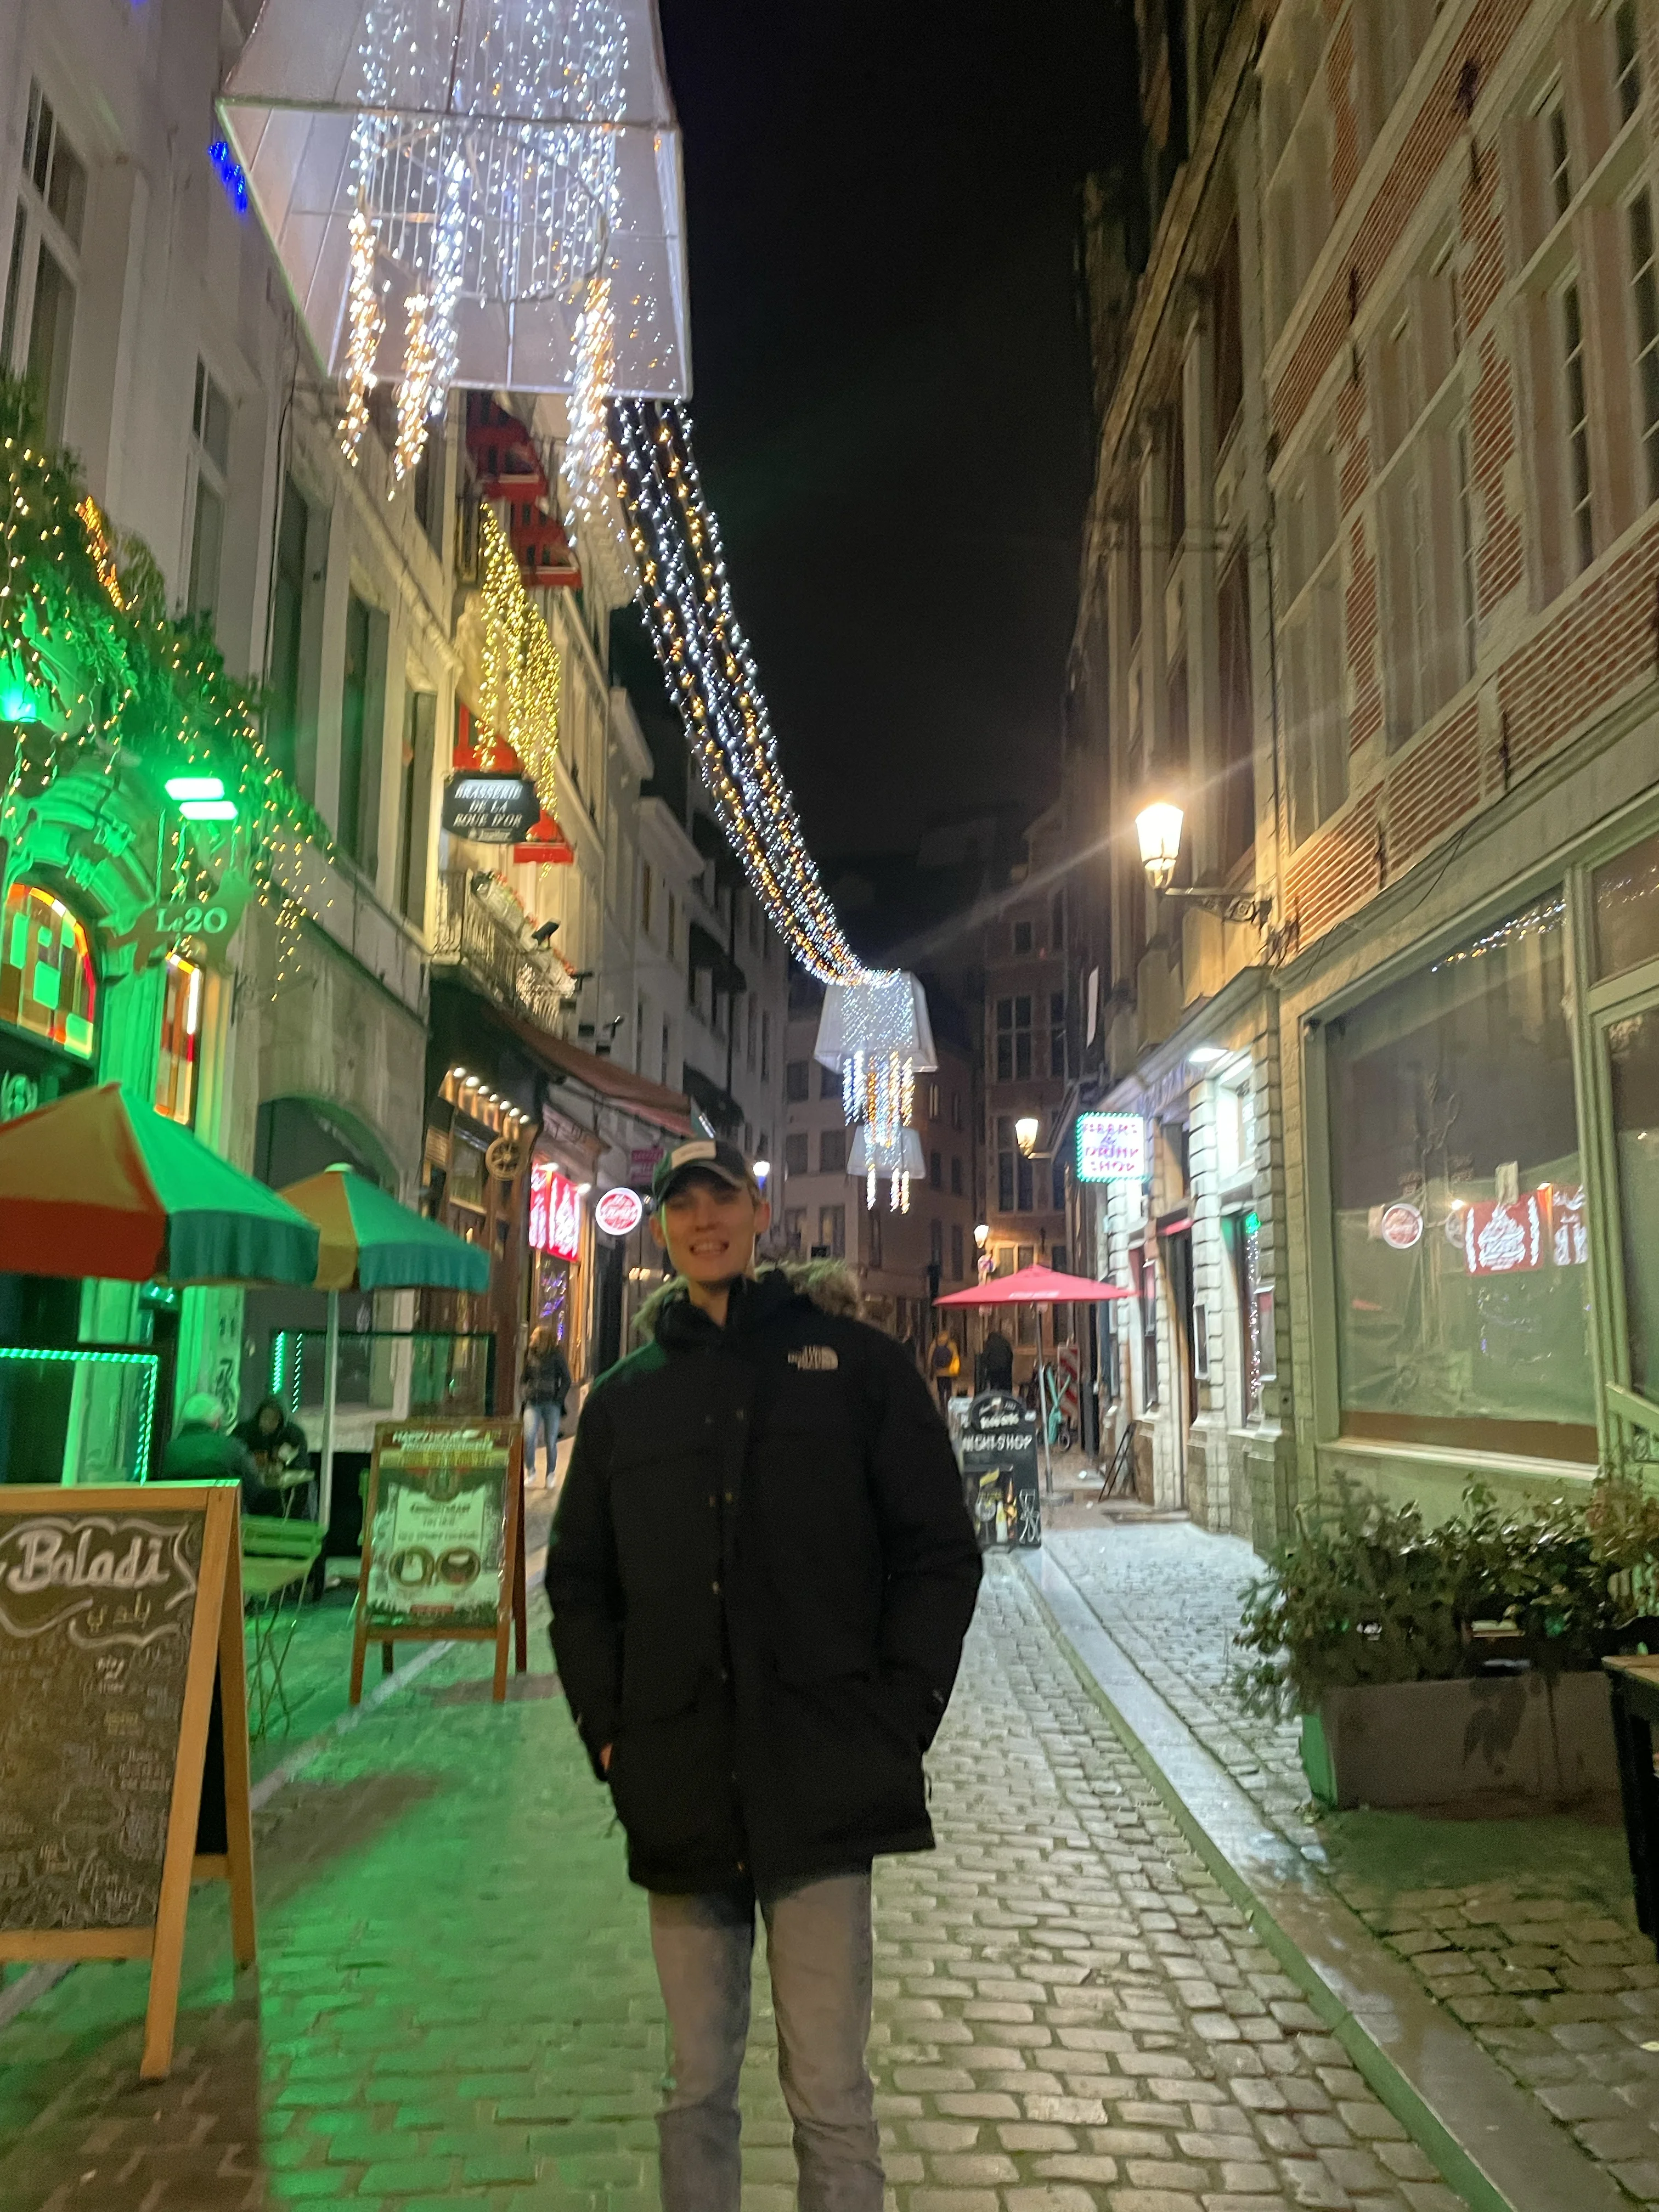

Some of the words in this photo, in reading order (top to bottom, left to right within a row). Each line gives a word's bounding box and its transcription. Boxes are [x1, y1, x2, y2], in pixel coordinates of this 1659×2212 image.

[454, 785, 523, 799] BRASSERIE
[469, 799, 488, 813] DE
[490, 799, 509, 813] LA
[453, 813, 489, 827] ROUE
[491, 813, 522, 827] D'OR
[5, 1528, 171, 1594] Baladi
